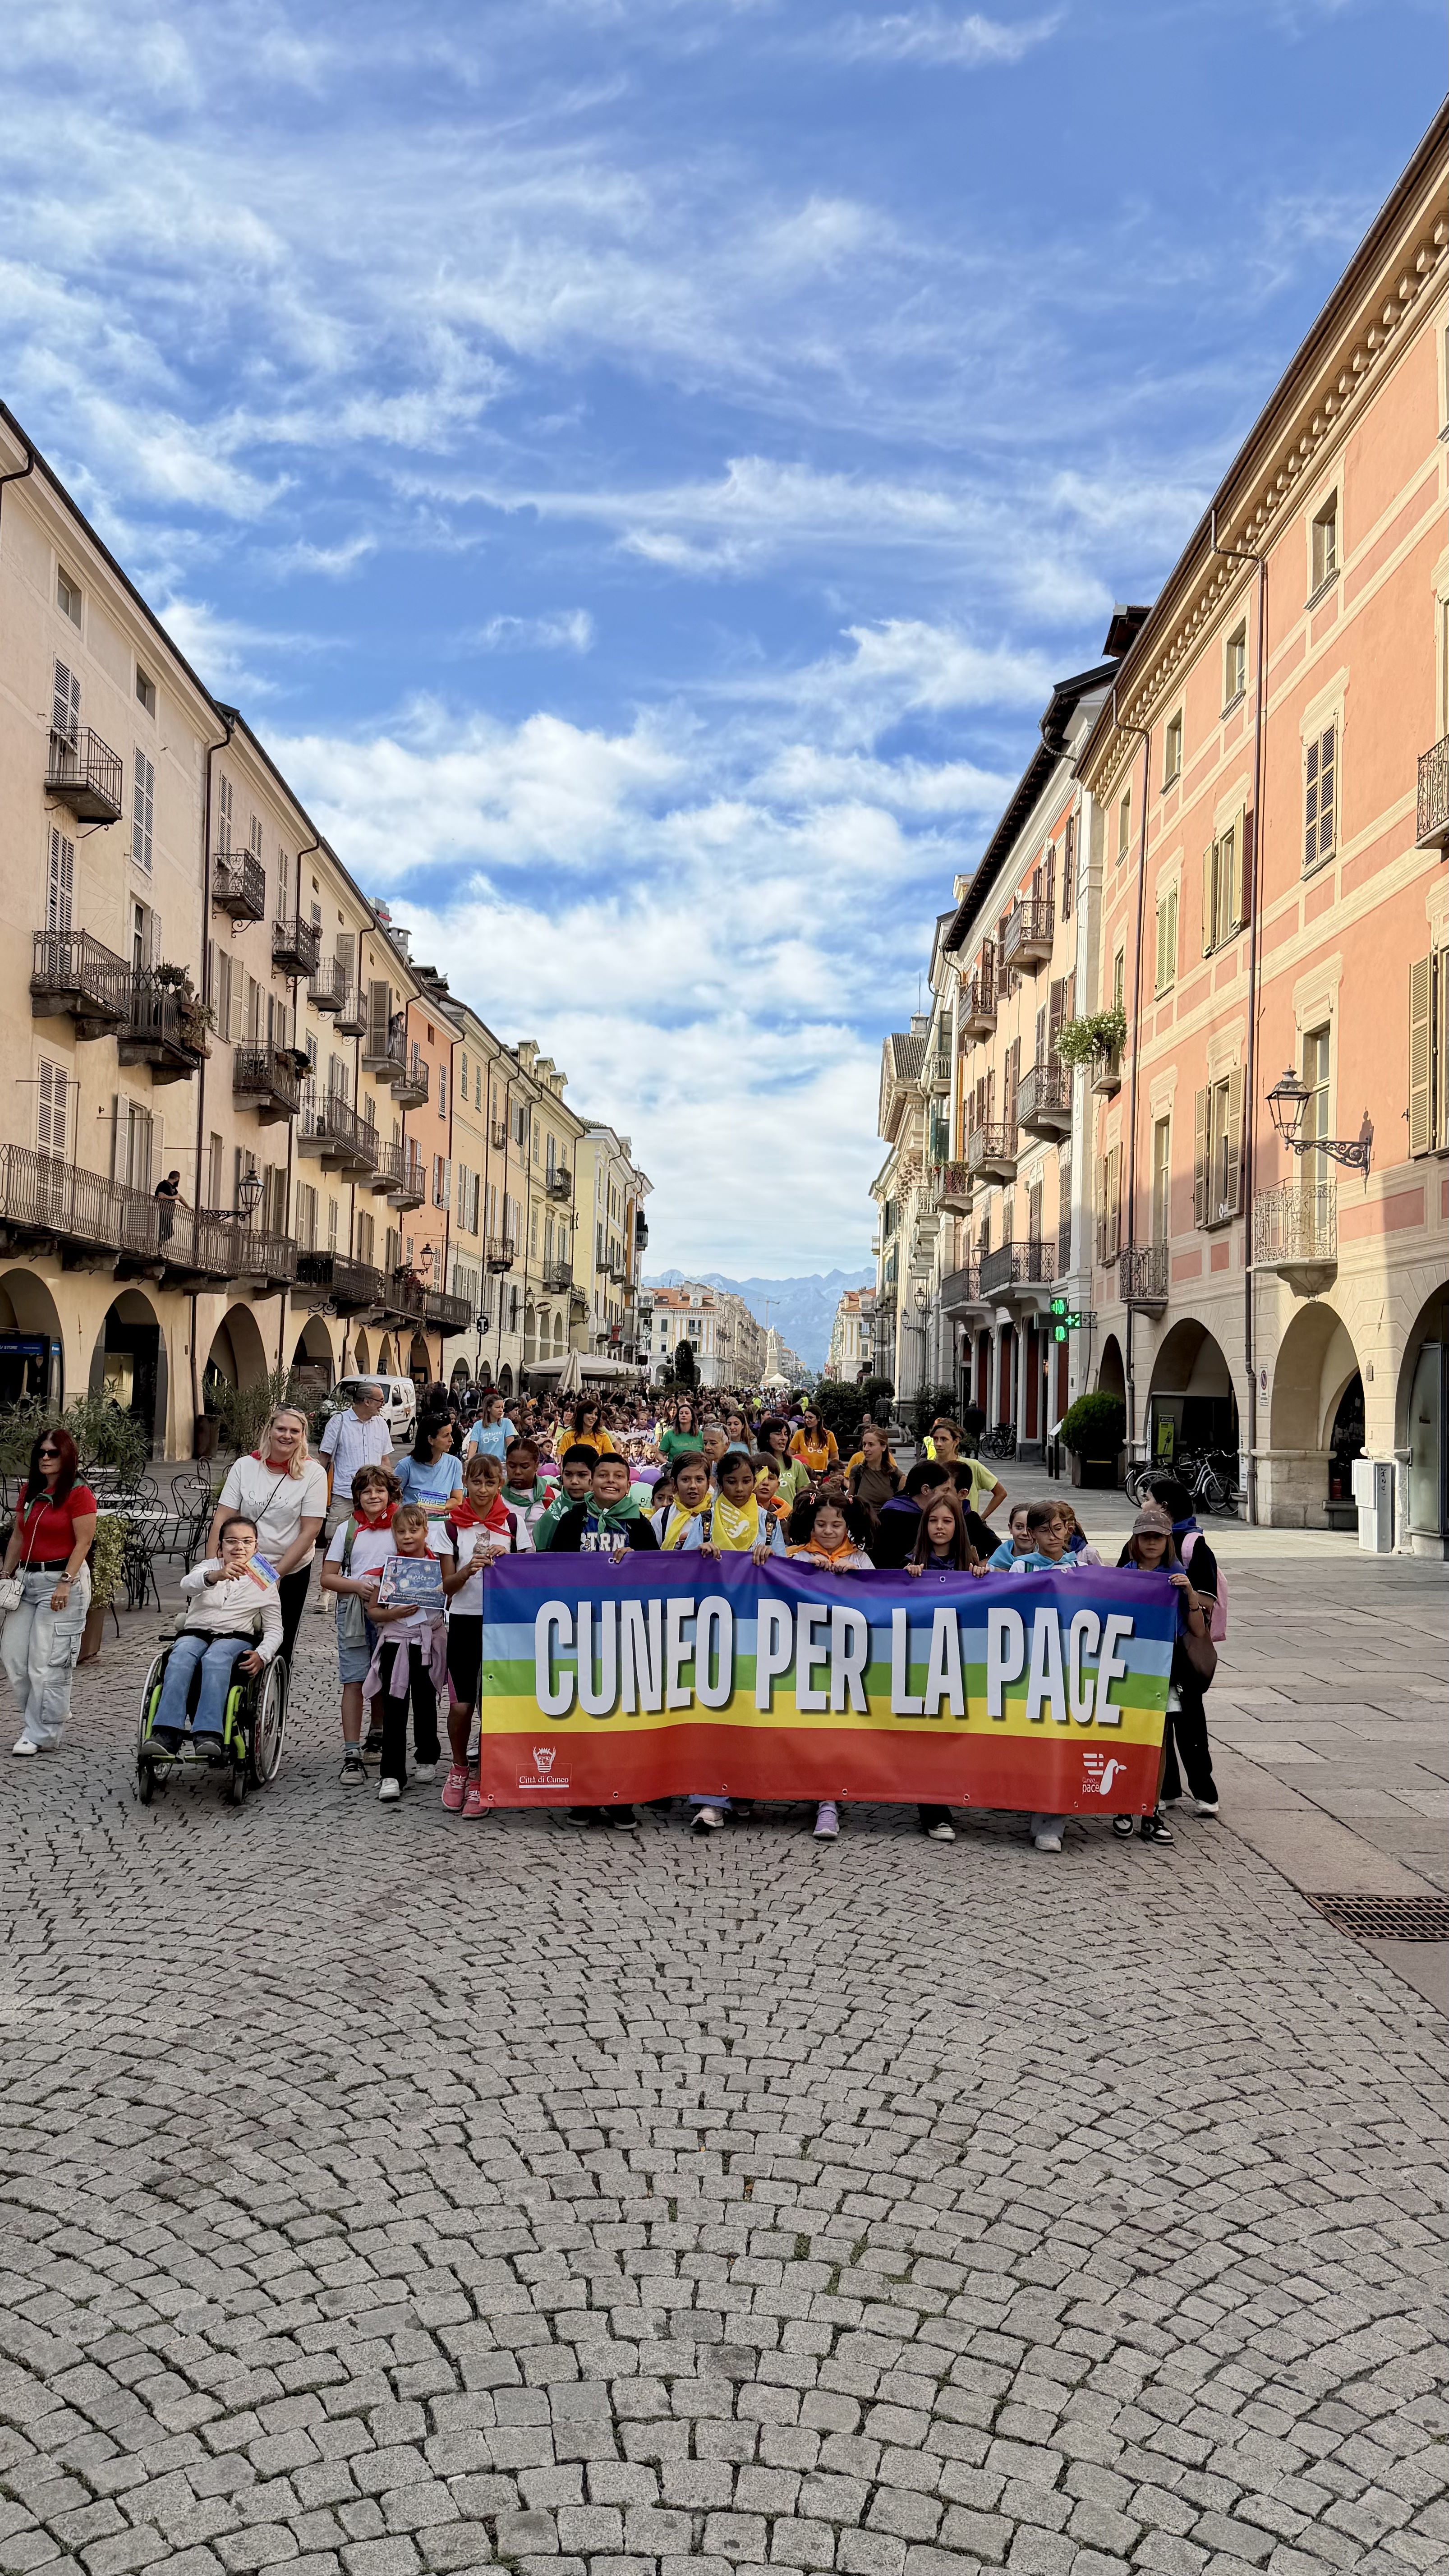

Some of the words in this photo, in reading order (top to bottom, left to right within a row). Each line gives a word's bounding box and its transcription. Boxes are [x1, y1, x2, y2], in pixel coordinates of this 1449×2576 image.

[483, 1435, 499, 1444] 0-6
[534, 1595, 733, 1716] CUNEO
[755, 1598, 868, 1712] PER
[891, 1607, 965, 1716] LA
[987, 1607, 1134, 1724] PACE
[1082, 1784, 1099, 1795] pace
